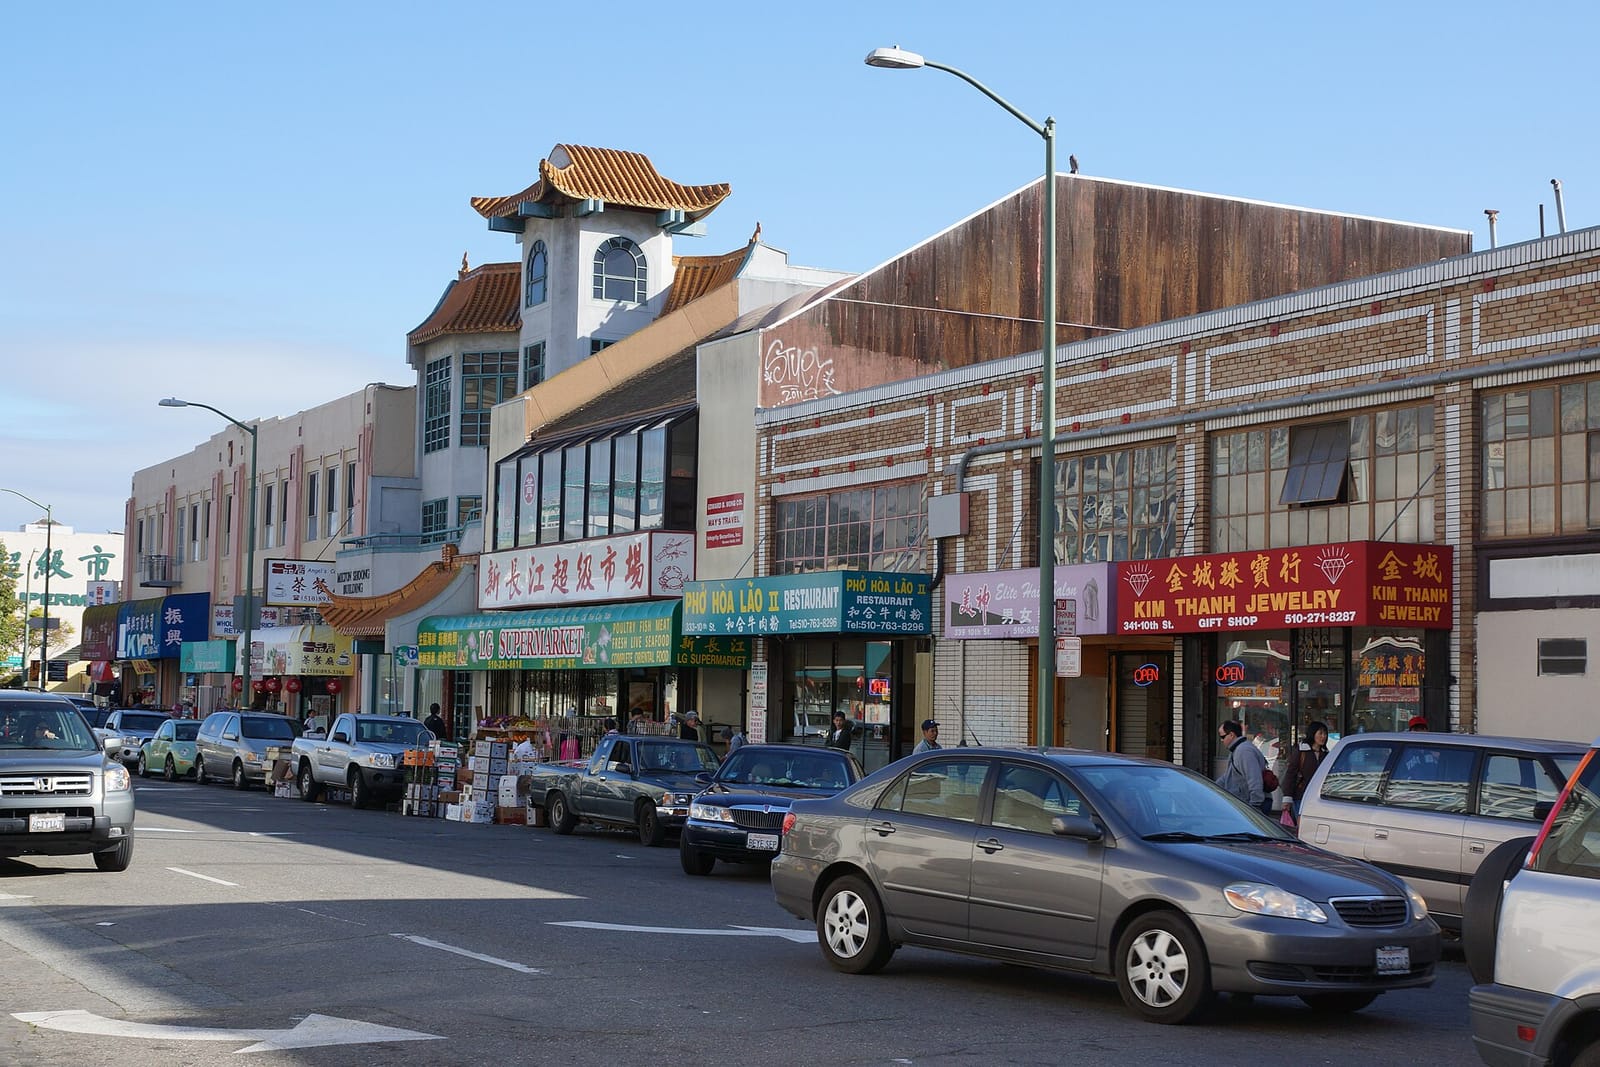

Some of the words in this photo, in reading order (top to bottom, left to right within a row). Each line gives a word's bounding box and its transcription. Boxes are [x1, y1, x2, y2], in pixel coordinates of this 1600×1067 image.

[1165, 552, 1302, 593] 金城珠寶行
[1378, 549, 1443, 584] 金城
[343, 583, 363, 595] BUILDING
[995, 583, 1018, 600] Elite
[1022, 582, 1040, 599] Hai
[1372, 585, 1399, 601] KIM
[1403, 587, 1448, 603] THANH
[784, 587, 840, 610] RESTAURANT
[856, 595, 914, 606] RESTAURANT
[1133, 600, 1165, 618] KIM
[1174, 596, 1236, 617] THANH
[1245, 589, 1341, 613] JEWELRY
[847, 606, 922, 621] 和合牛肉粉
[1379, 605, 1441, 621] JEWELRY
[164, 608, 184, 647] 振興
[613, 621, 635, 634] POULTRY
[640, 620, 652, 632] FISH
[655, 617, 671, 631] MEAT
[725, 615, 780, 633] 和合牛肉粉
[846, 620, 925, 631] Tel:510-763-8296
[1161, 619, 1175, 630] St.
[1198, 618, 1222, 628] GIFT
[1227, 616, 1258, 627] SHOP
[479, 630, 494, 661] LG
[498, 626, 584, 661] SUPERMARKET
[612, 637, 627, 650] FRESH
[630, 636, 642, 649] LIVE
[645, 634, 670, 648] SEAFOOD
[680, 636, 745, 653] 新長江
[656, 649, 669, 663] FOOD
[677, 653, 688, 664] LG
[690, 653, 746, 666] SUPERMARKET
[1134, 668, 1158, 682] OPEN
[1215, 667, 1244, 682] OPEN
